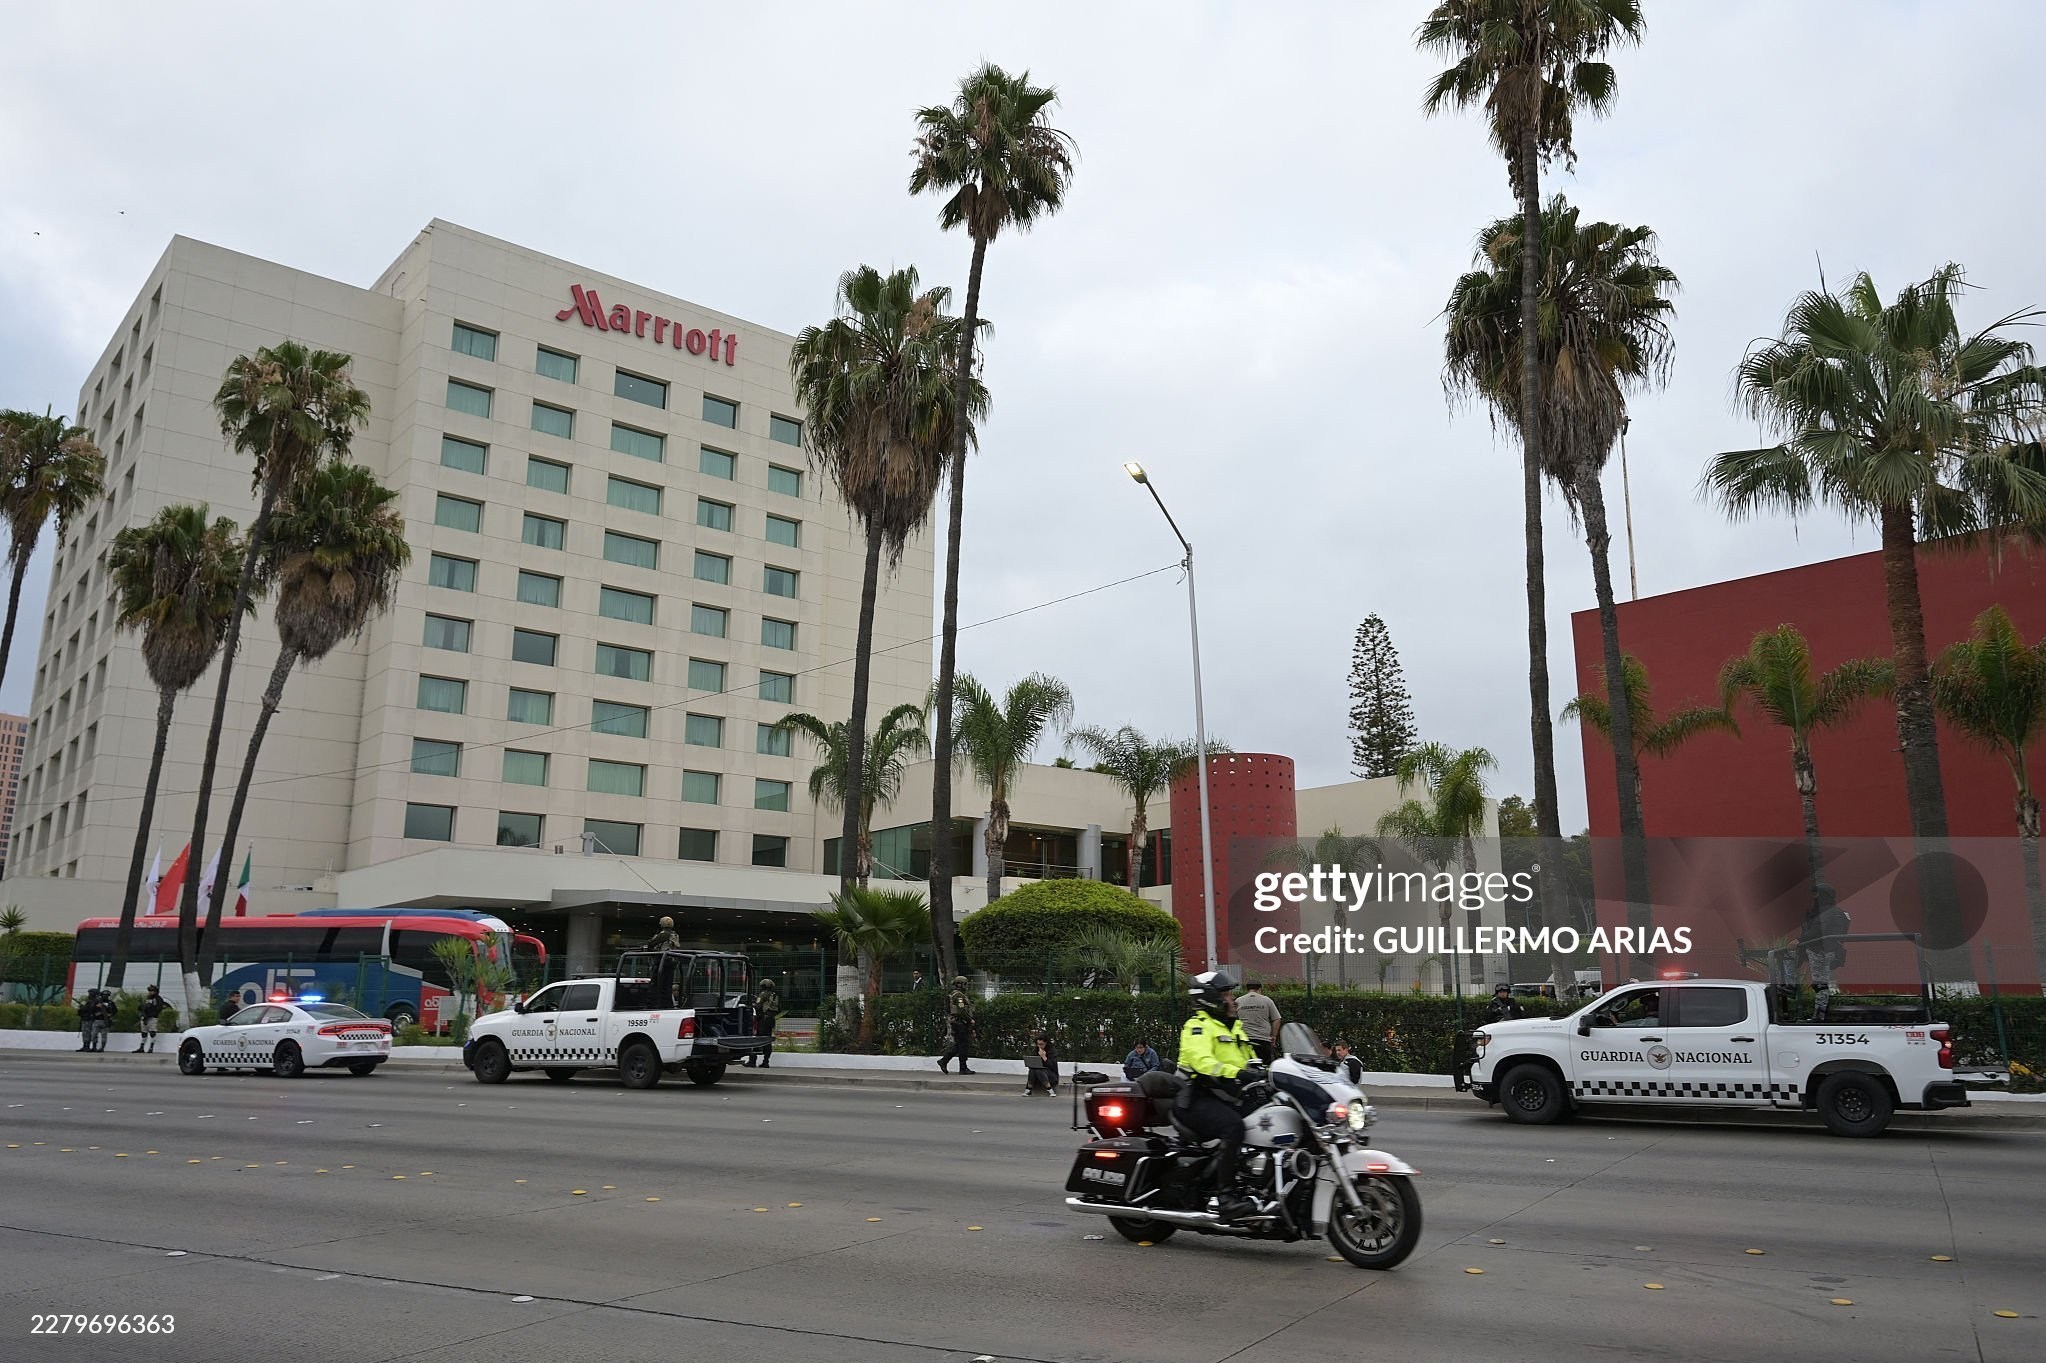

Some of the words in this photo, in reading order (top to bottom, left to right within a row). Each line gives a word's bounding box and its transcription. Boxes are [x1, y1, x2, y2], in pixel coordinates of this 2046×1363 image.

[555, 283, 738, 366] Marriott
[628, 1019, 648, 1027] 19589
[511, 1029, 544, 1037] GUARDIA
[559, 1028, 597, 1036] NACIONAL
[1815, 1033, 1870, 1045] 31354
[1580, 1050, 1644, 1063] GUARDIA
[1675, 1051, 1752, 1064] NACIONAL
